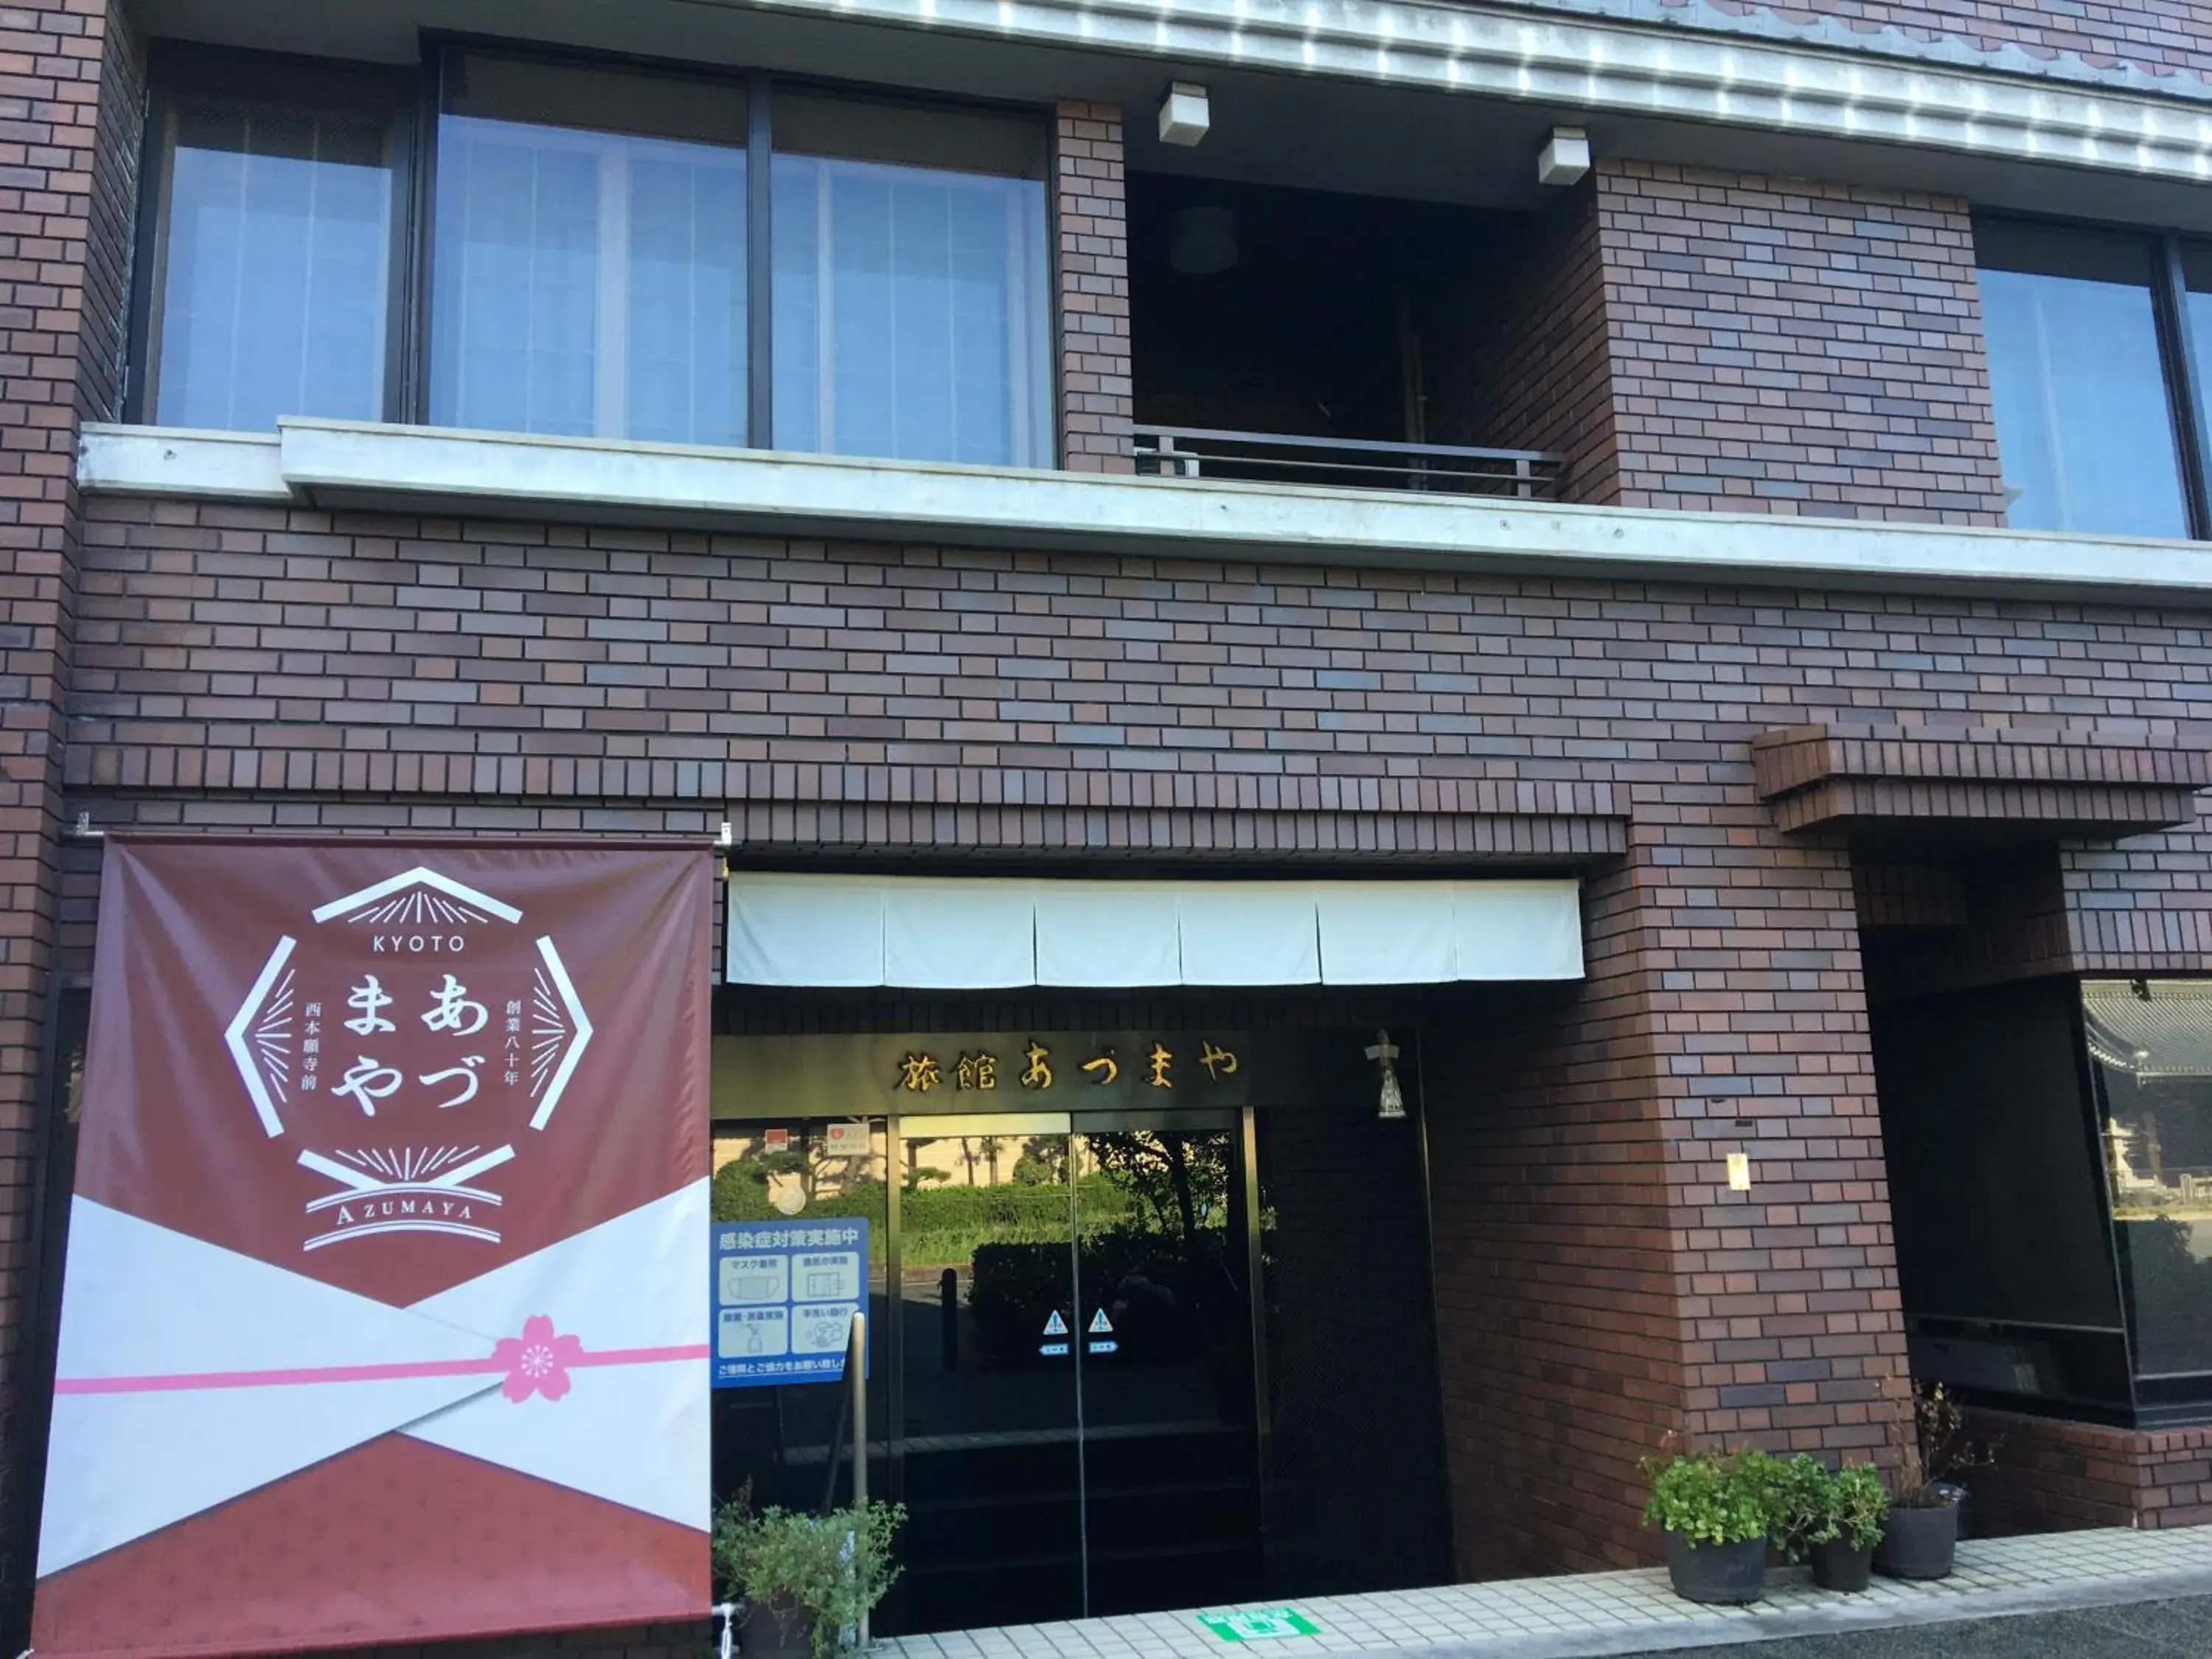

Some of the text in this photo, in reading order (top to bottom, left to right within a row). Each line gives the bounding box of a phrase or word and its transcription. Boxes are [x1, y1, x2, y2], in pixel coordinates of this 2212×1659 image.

[373, 935, 465, 953] KYOTO
[301, 1002, 321, 1091] 西本願寺前
[504, 1000, 521, 1086] 創業八十年
[336, 1200, 473, 1225] AZUMAYA
[719, 1227, 859, 1251] 感染症対策実施中
